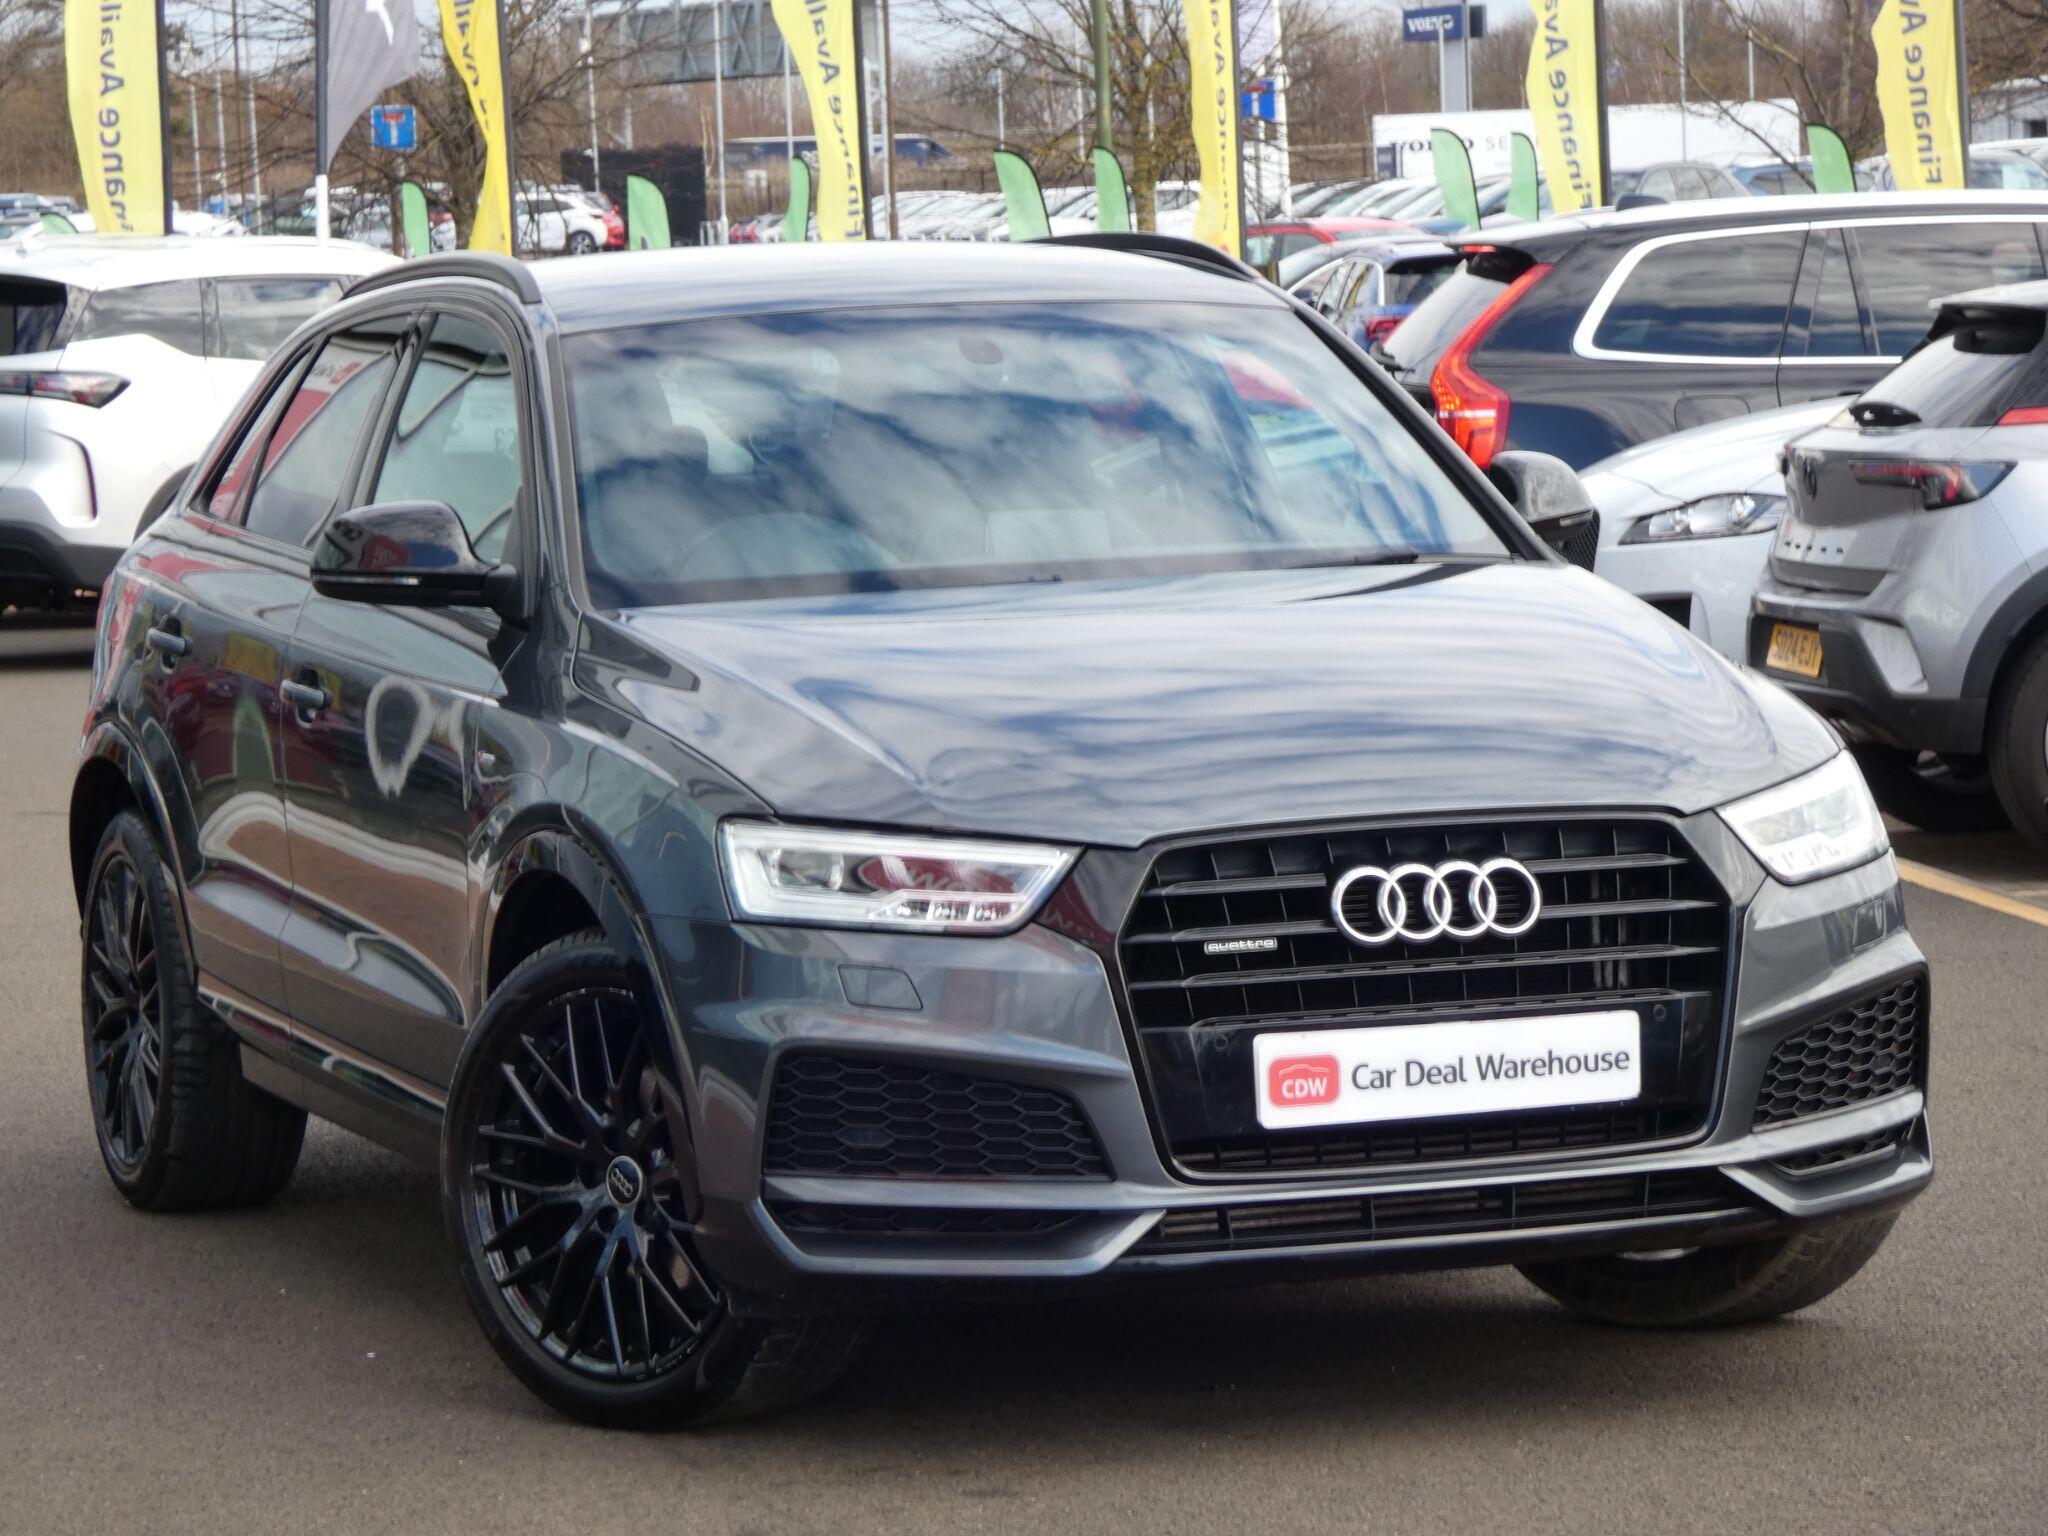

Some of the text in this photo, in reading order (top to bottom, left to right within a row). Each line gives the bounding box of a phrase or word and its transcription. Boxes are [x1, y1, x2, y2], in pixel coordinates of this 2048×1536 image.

[1207, 939, 1275, 952] quattro
[1351, 1048, 1631, 1090] Car Deal Warehouse
[1281, 1077, 1328, 1099] CDW
